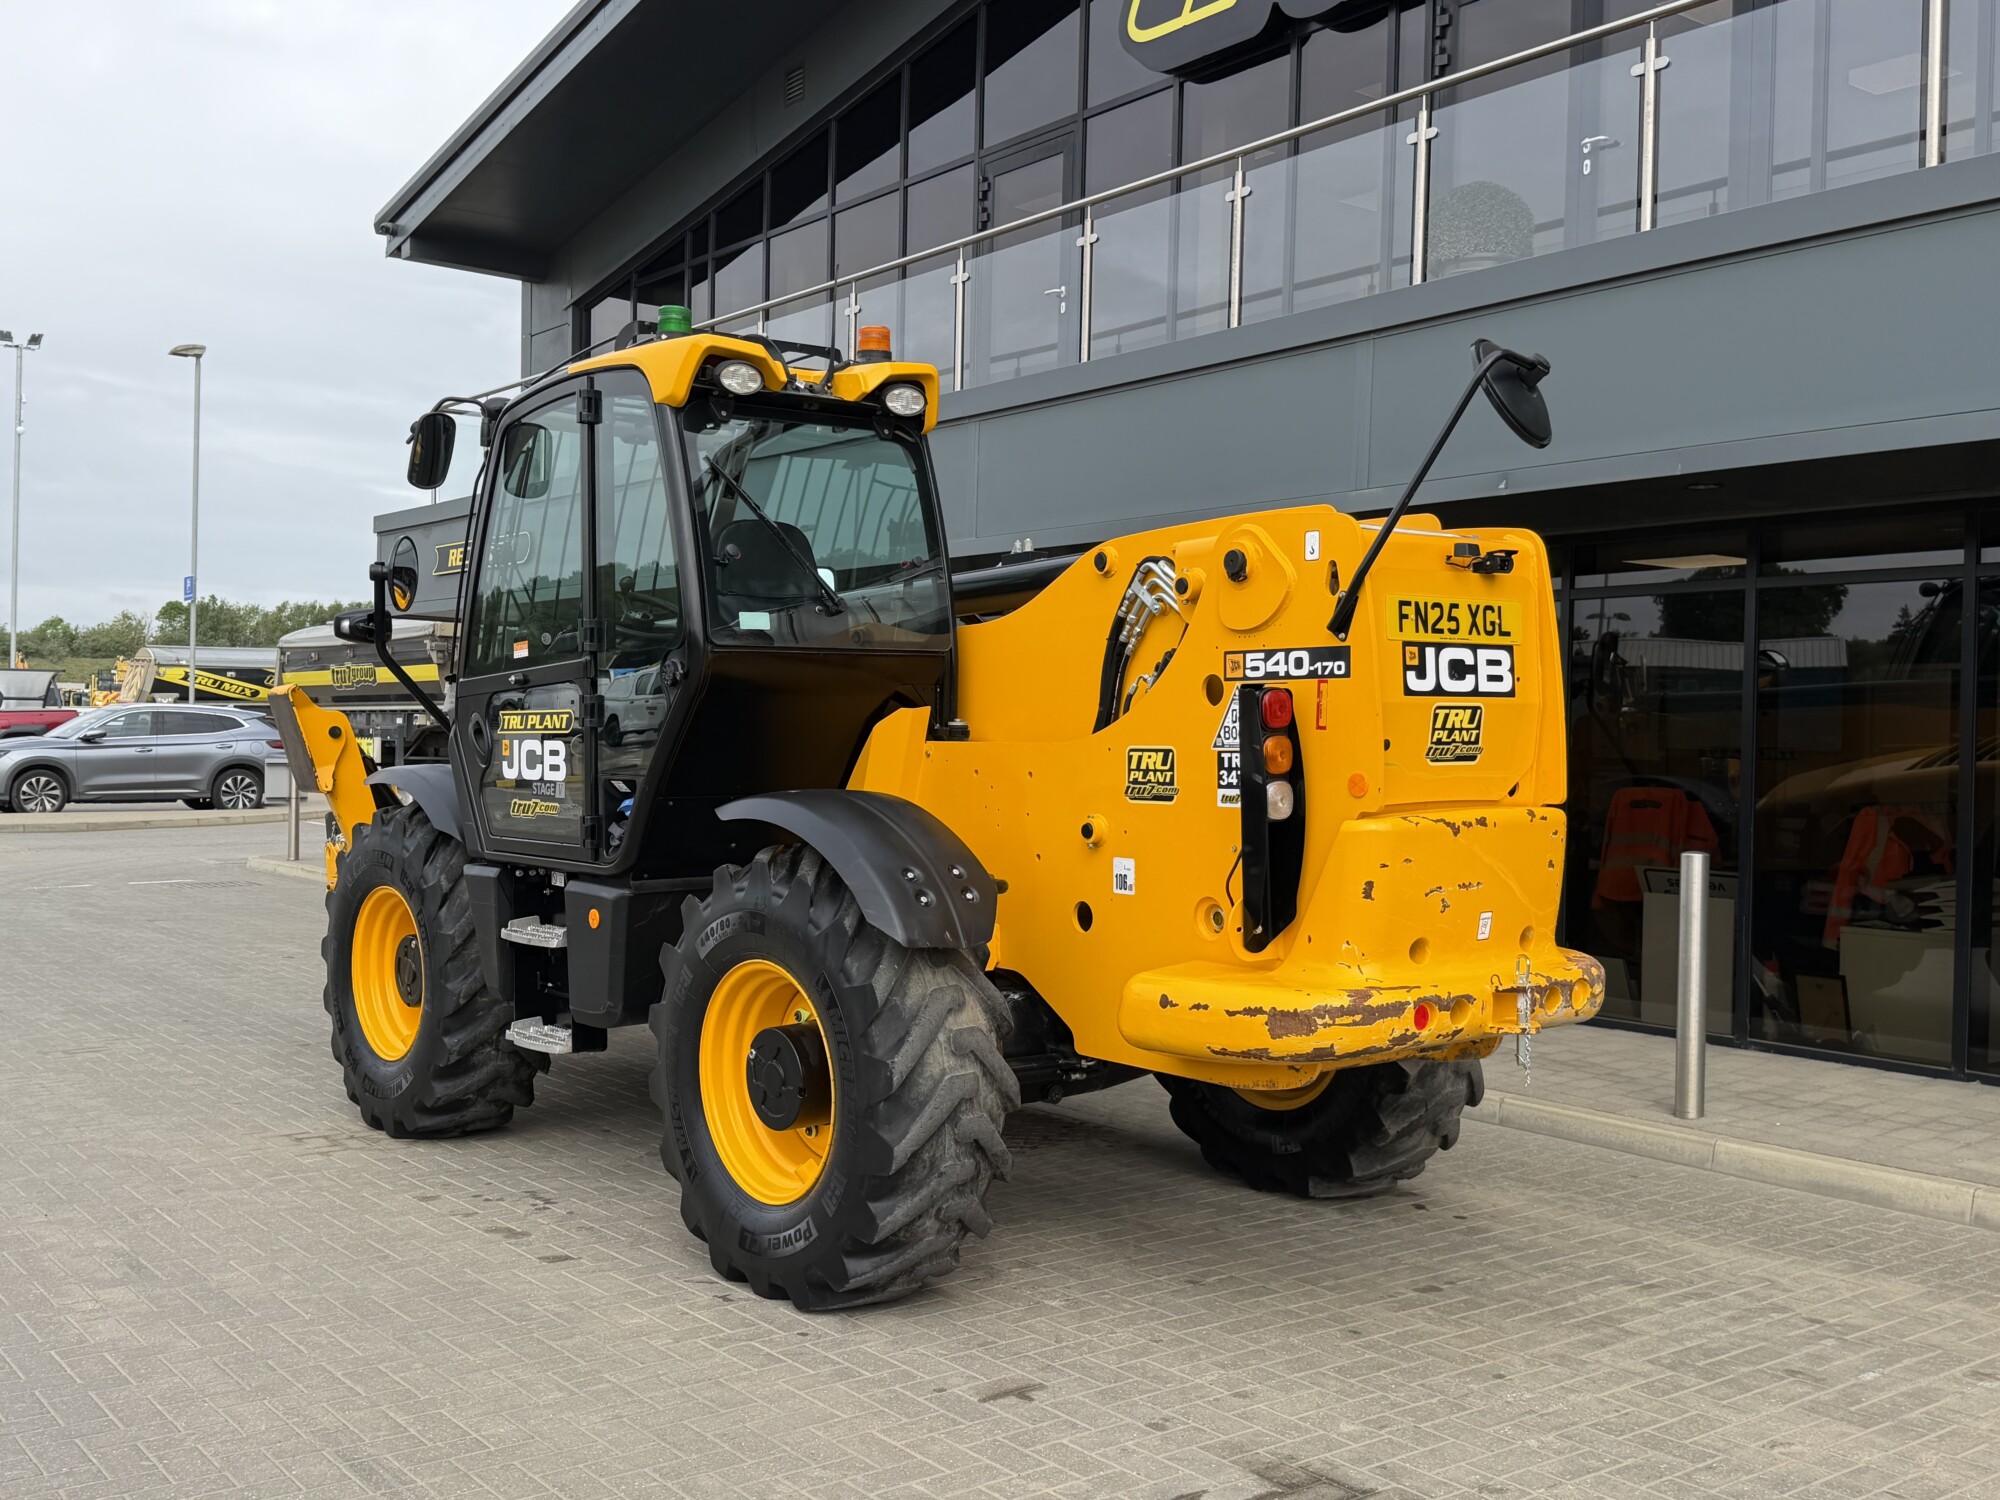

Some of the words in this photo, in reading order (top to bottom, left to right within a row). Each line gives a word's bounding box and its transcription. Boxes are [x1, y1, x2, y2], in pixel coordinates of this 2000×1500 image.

[1398, 600, 1460, 635] FN25
[1467, 603, 1511, 637] XGL
[1405, 646, 1513, 693] JCB
[220, 681, 257, 698] MIX
[503, 714, 527, 730] TRU
[527, 714, 570, 729] PLANT
[1434, 709, 1482, 729] TRU
[1432, 729, 1480, 743] PLANT
[1425, 744, 1483, 758] tru7.com
[502, 739, 567, 782] JCB
[1129, 751, 1173, 770] TRU
[1129, 770, 1174, 783] PLANT
[532, 782, 555, 796] STAGE
[1124, 784, 1180, 798] tru7.com
[511, 799, 559, 816] tru7.com
[1115, 872, 1128, 891] 106
